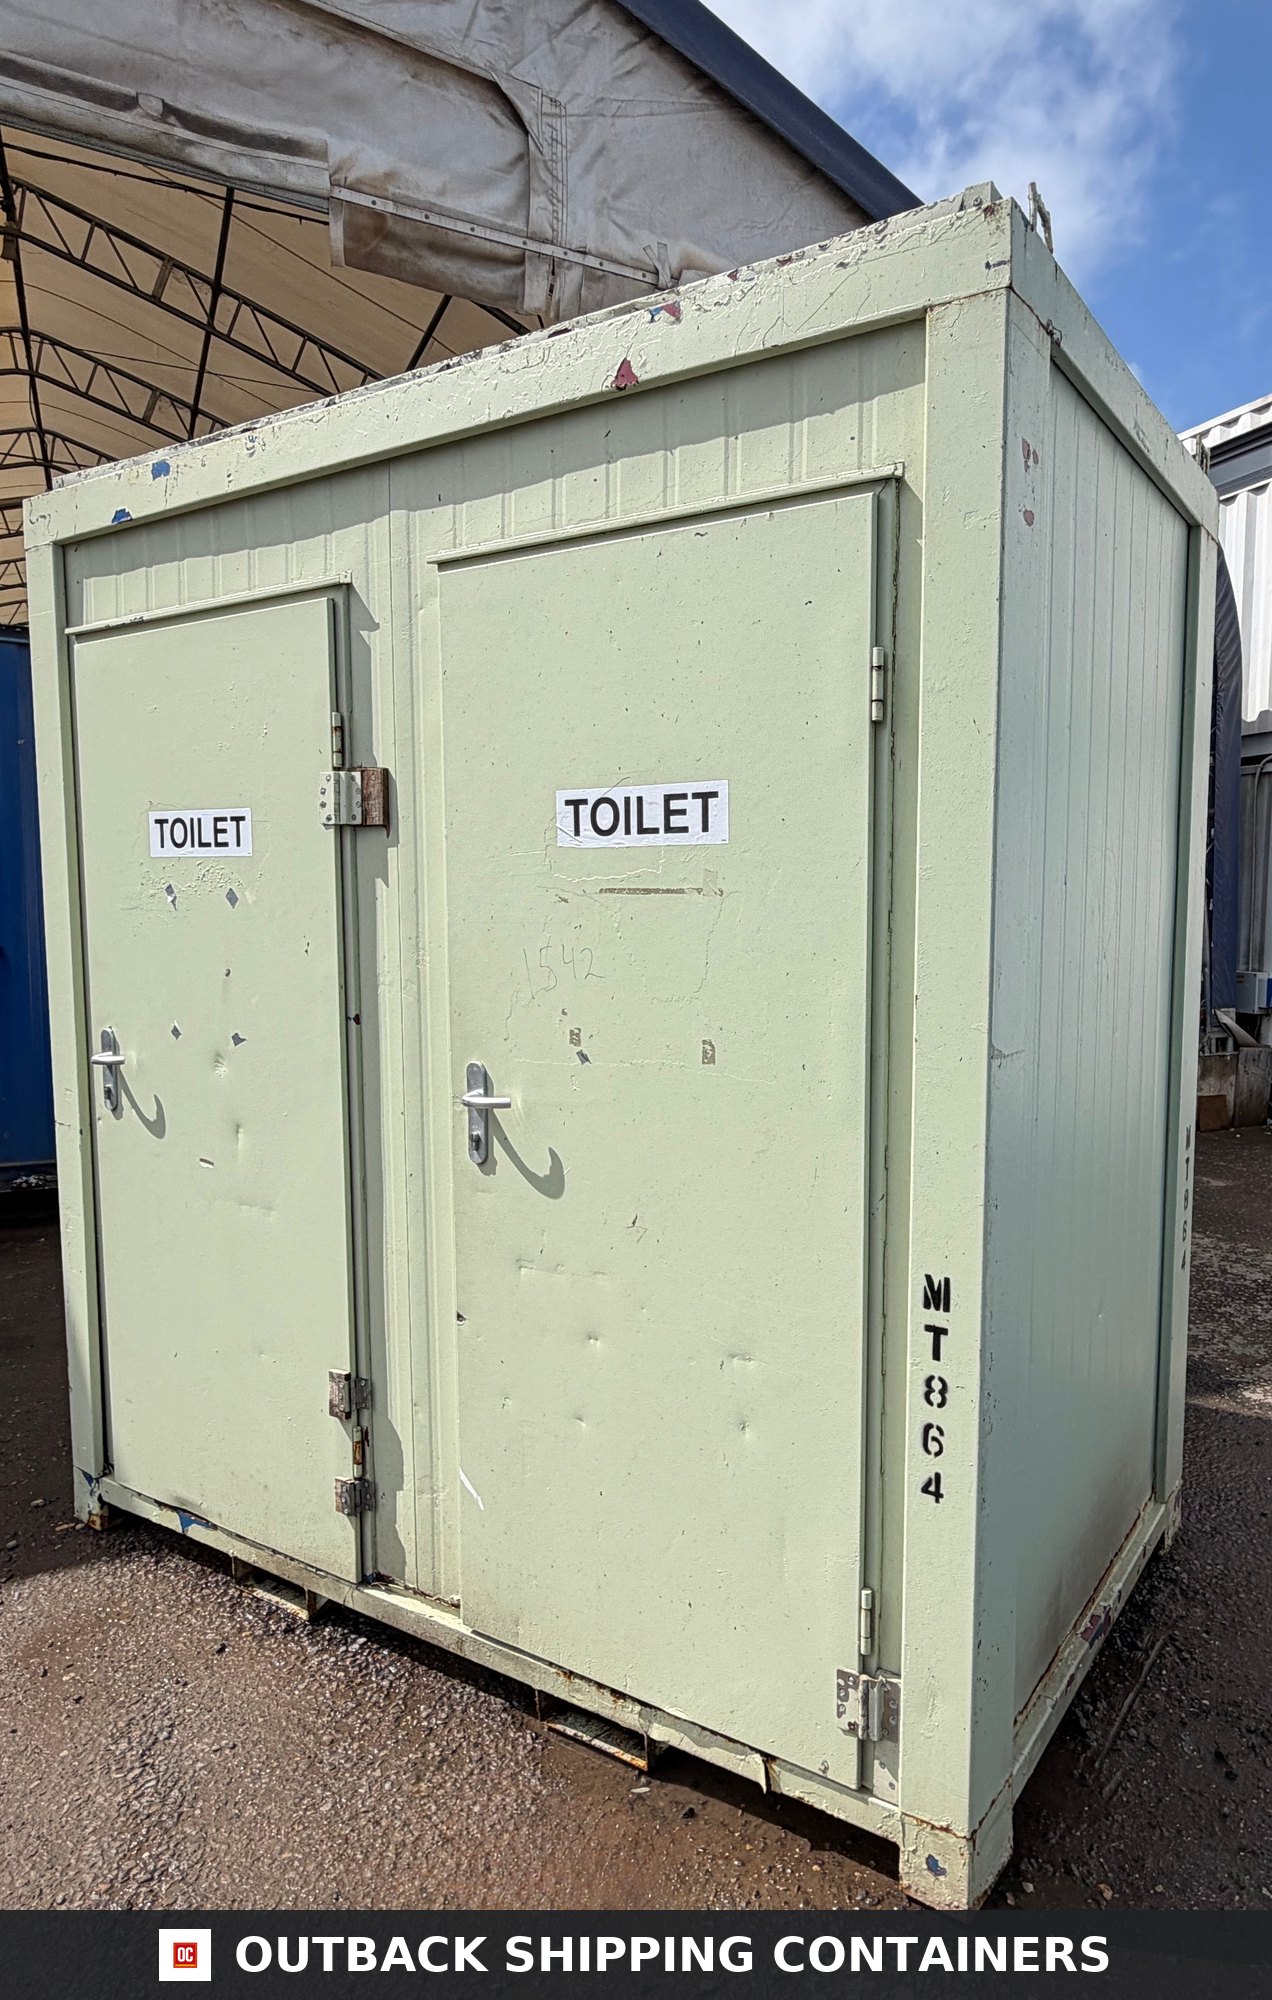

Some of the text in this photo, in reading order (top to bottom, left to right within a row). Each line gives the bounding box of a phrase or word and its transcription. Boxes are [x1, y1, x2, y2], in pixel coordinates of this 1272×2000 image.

[154, 815, 246, 849] TOILET
[563, 791, 719, 837] TOILET
[522, 943, 608, 1000] 1542
[920, 1273, 951, 1504] MT864
